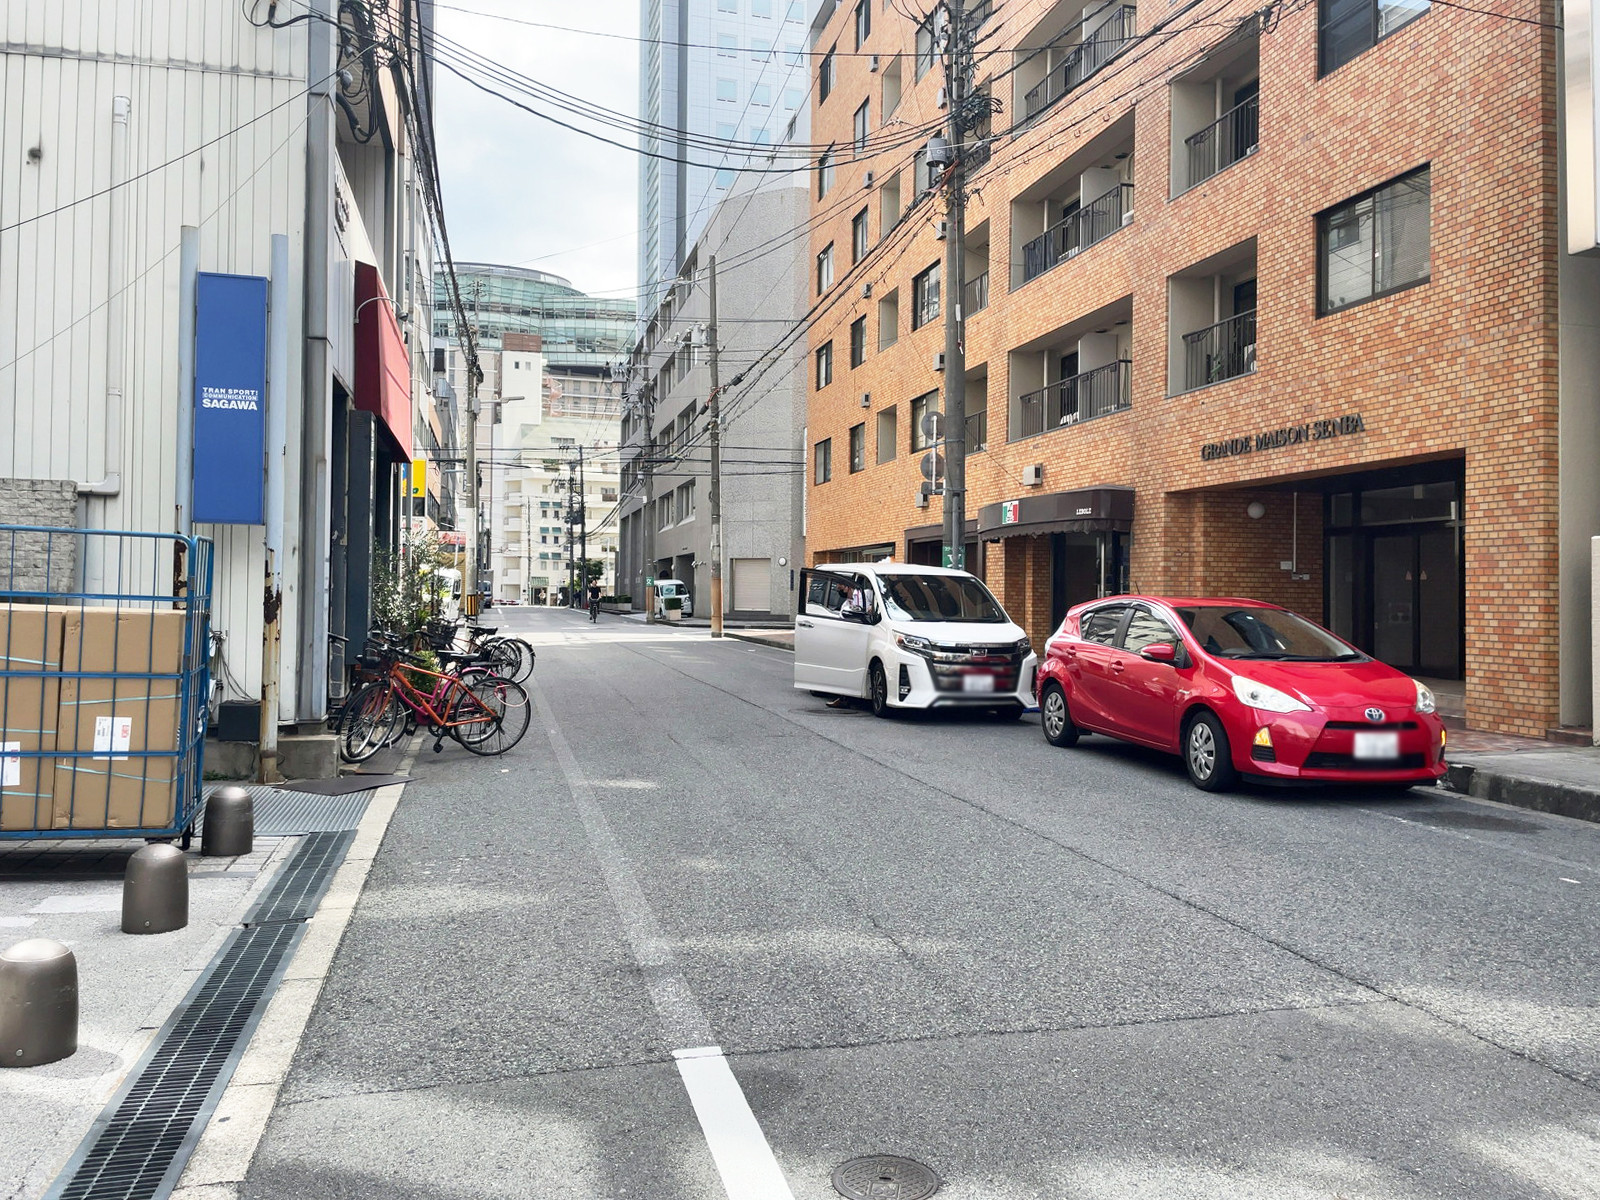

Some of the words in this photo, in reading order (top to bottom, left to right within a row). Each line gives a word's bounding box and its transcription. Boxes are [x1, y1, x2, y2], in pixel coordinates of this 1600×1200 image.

[202, 398, 258, 411] SAGAWA
[1201, 436, 1252, 461] GRANDE
[1255, 424, 1310, 450] MAISON
[1312, 413, 1366, 440] SENBA
